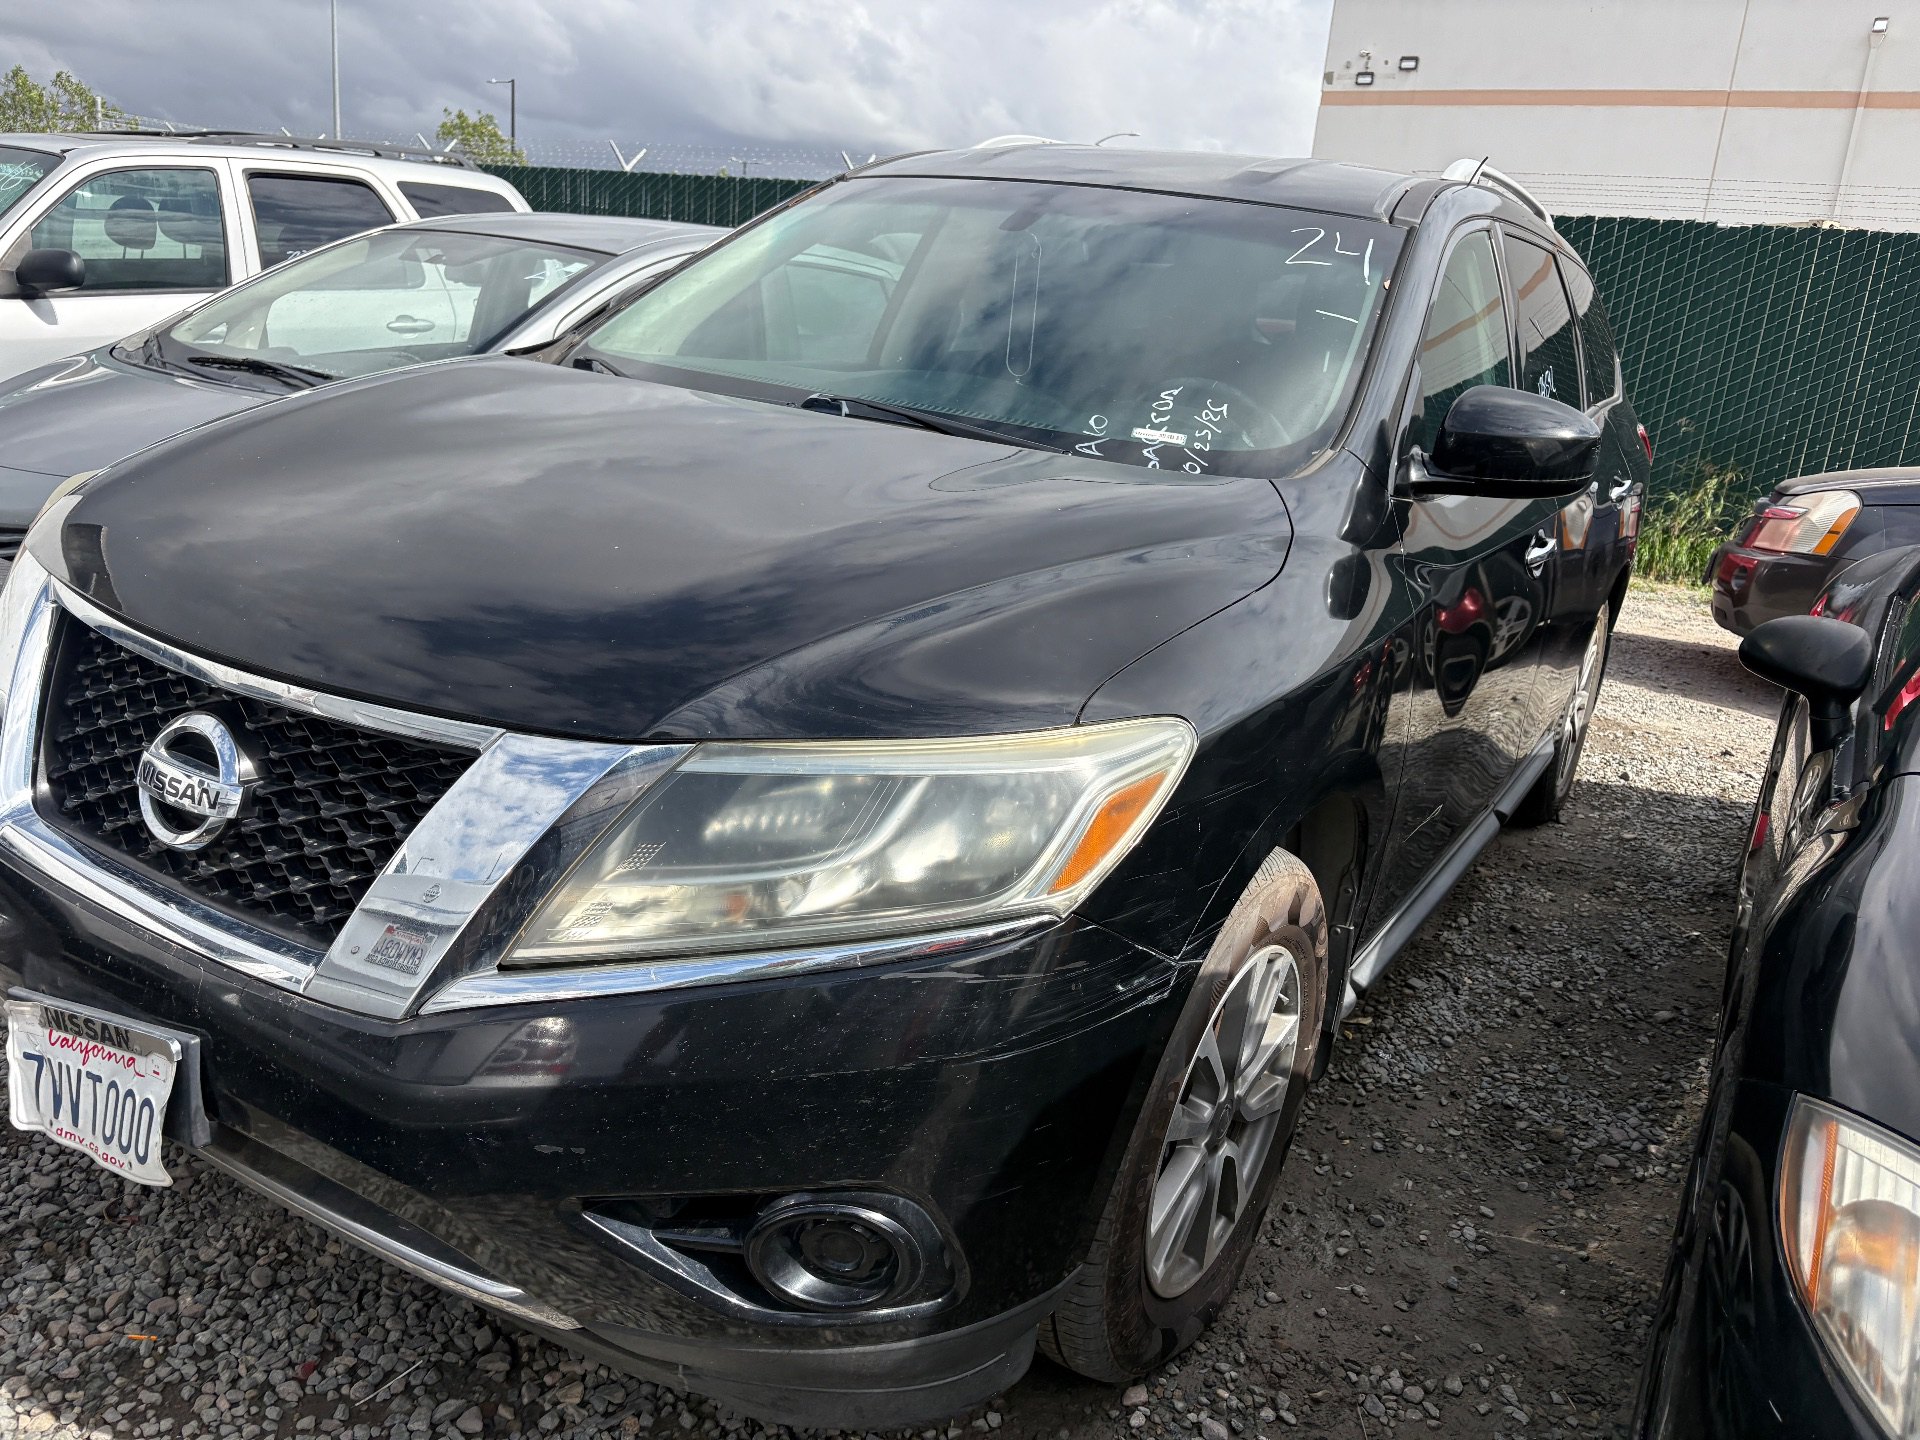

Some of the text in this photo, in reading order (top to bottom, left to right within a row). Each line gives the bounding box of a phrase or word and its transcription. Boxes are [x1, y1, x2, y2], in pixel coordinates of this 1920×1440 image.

[141, 760, 221, 810] NISSAN
[43, 1006, 130, 1049] NISSAN
[23, 1051, 155, 1165] 7VVT000
[55, 1127, 126, 1169] dmv.ca.gov
